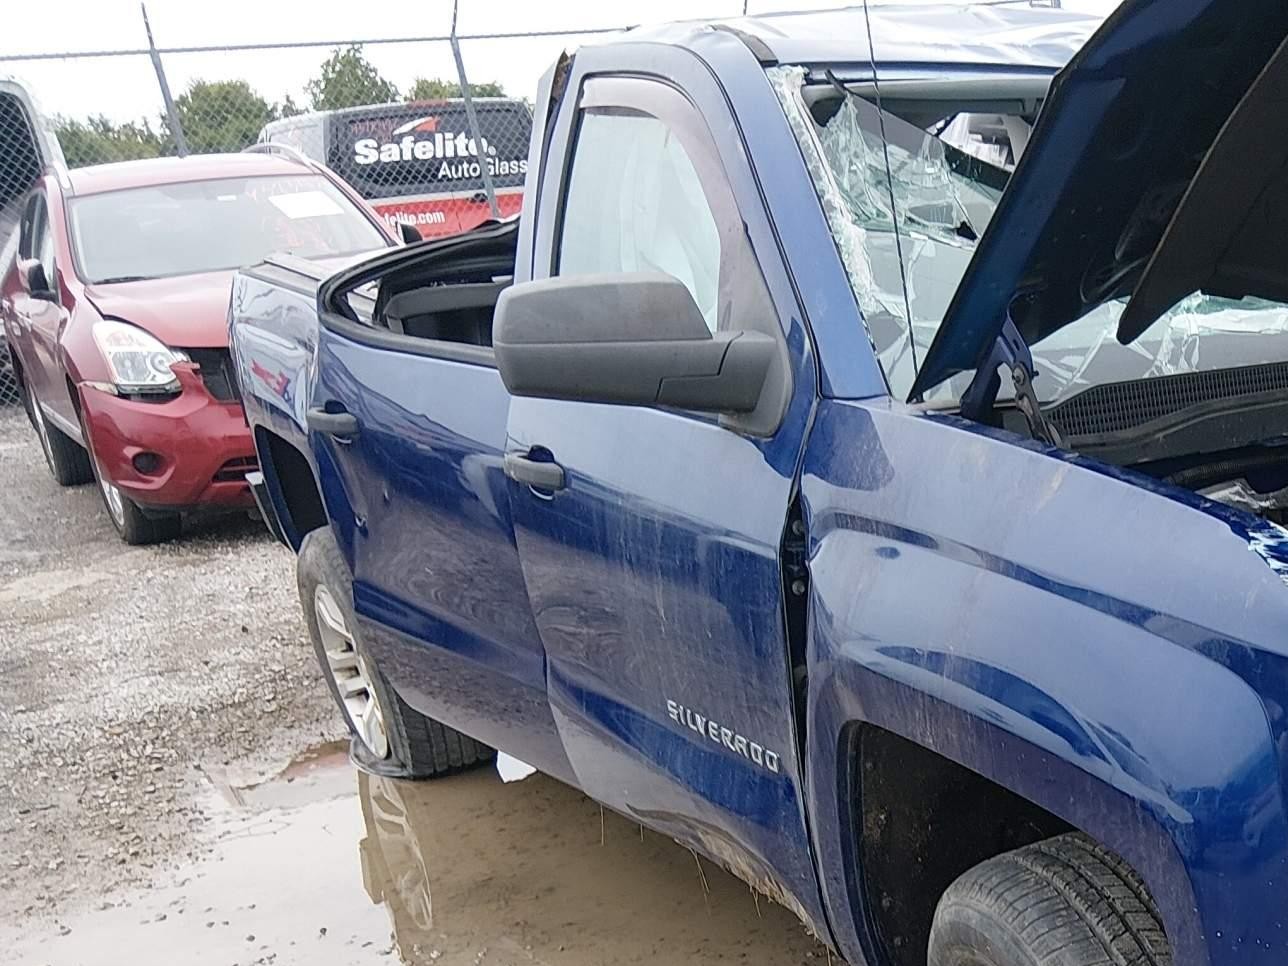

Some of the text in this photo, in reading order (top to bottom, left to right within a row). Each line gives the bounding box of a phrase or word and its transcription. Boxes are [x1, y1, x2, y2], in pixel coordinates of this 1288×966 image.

[438, 158, 528, 179] Auto Glass
[382, 210, 446, 225] felite.com
[667, 699, 780, 774] SILVERADO
